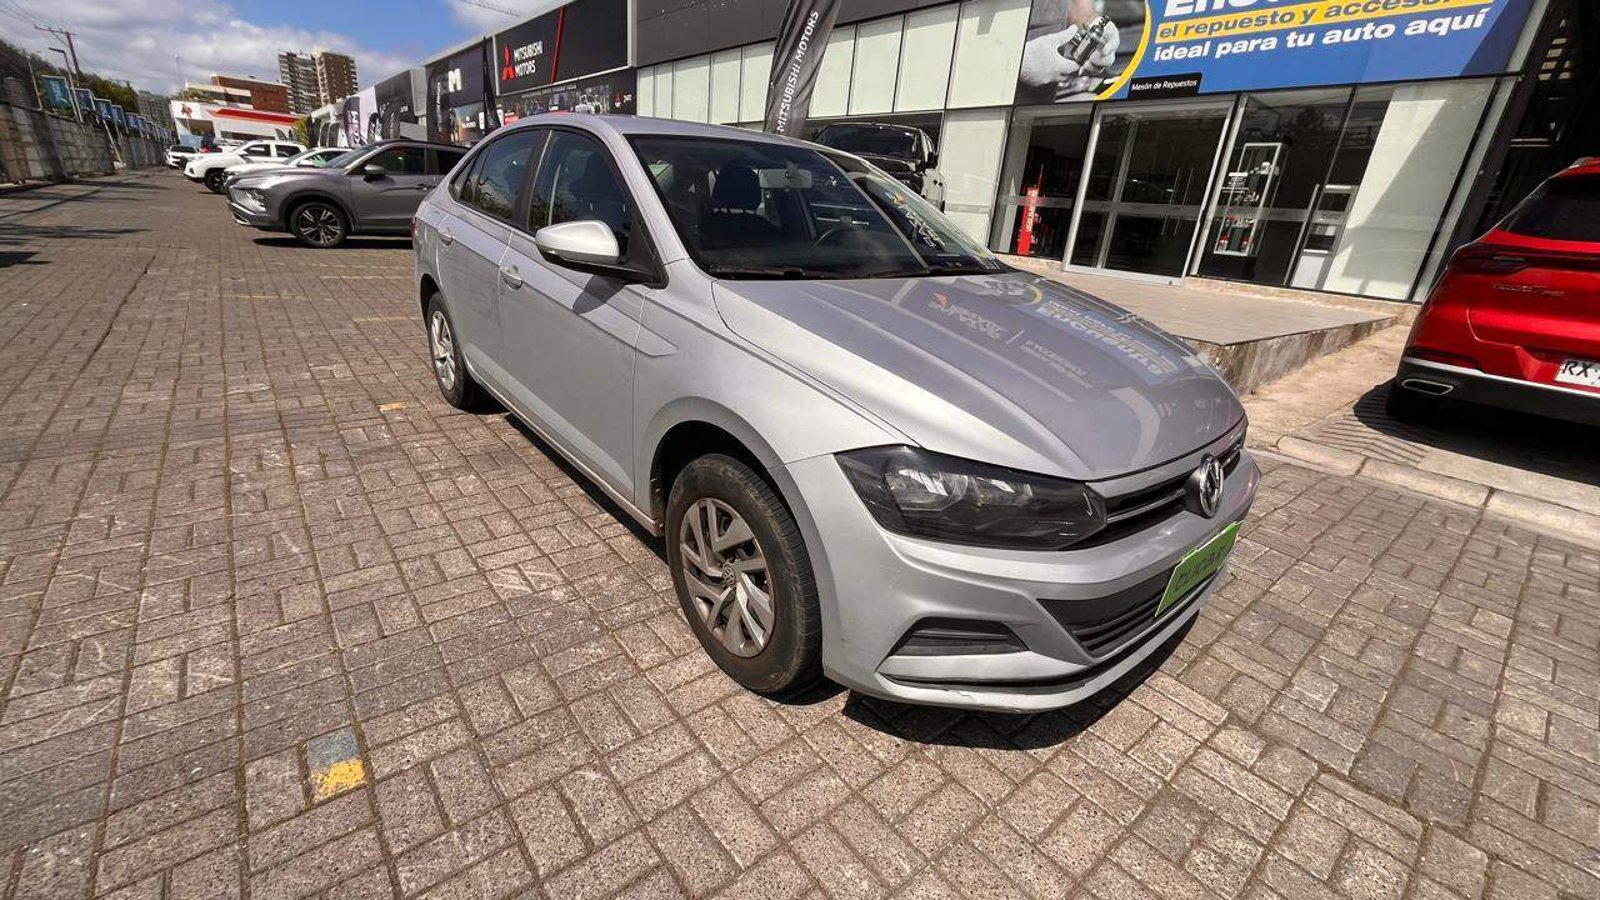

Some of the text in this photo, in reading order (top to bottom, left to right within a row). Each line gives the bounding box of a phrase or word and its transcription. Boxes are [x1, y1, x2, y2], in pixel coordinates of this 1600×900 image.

[1154, 7, 1491, 61] ideal para tu auto aquí
[1159, 24, 1178, 38] el
[1184, 9, 1295, 36] repuesto
[1300, 8, 1317, 24] y
[513, 40, 543, 62] MITSUBISHI
[514, 59, 536, 79] MOTORS
[776, 10, 819, 132] MITSUBISHI MOTORS
[1131, 80, 1197, 91] Mesón de Repuestos
[1562, 360, 1600, 380] RX
